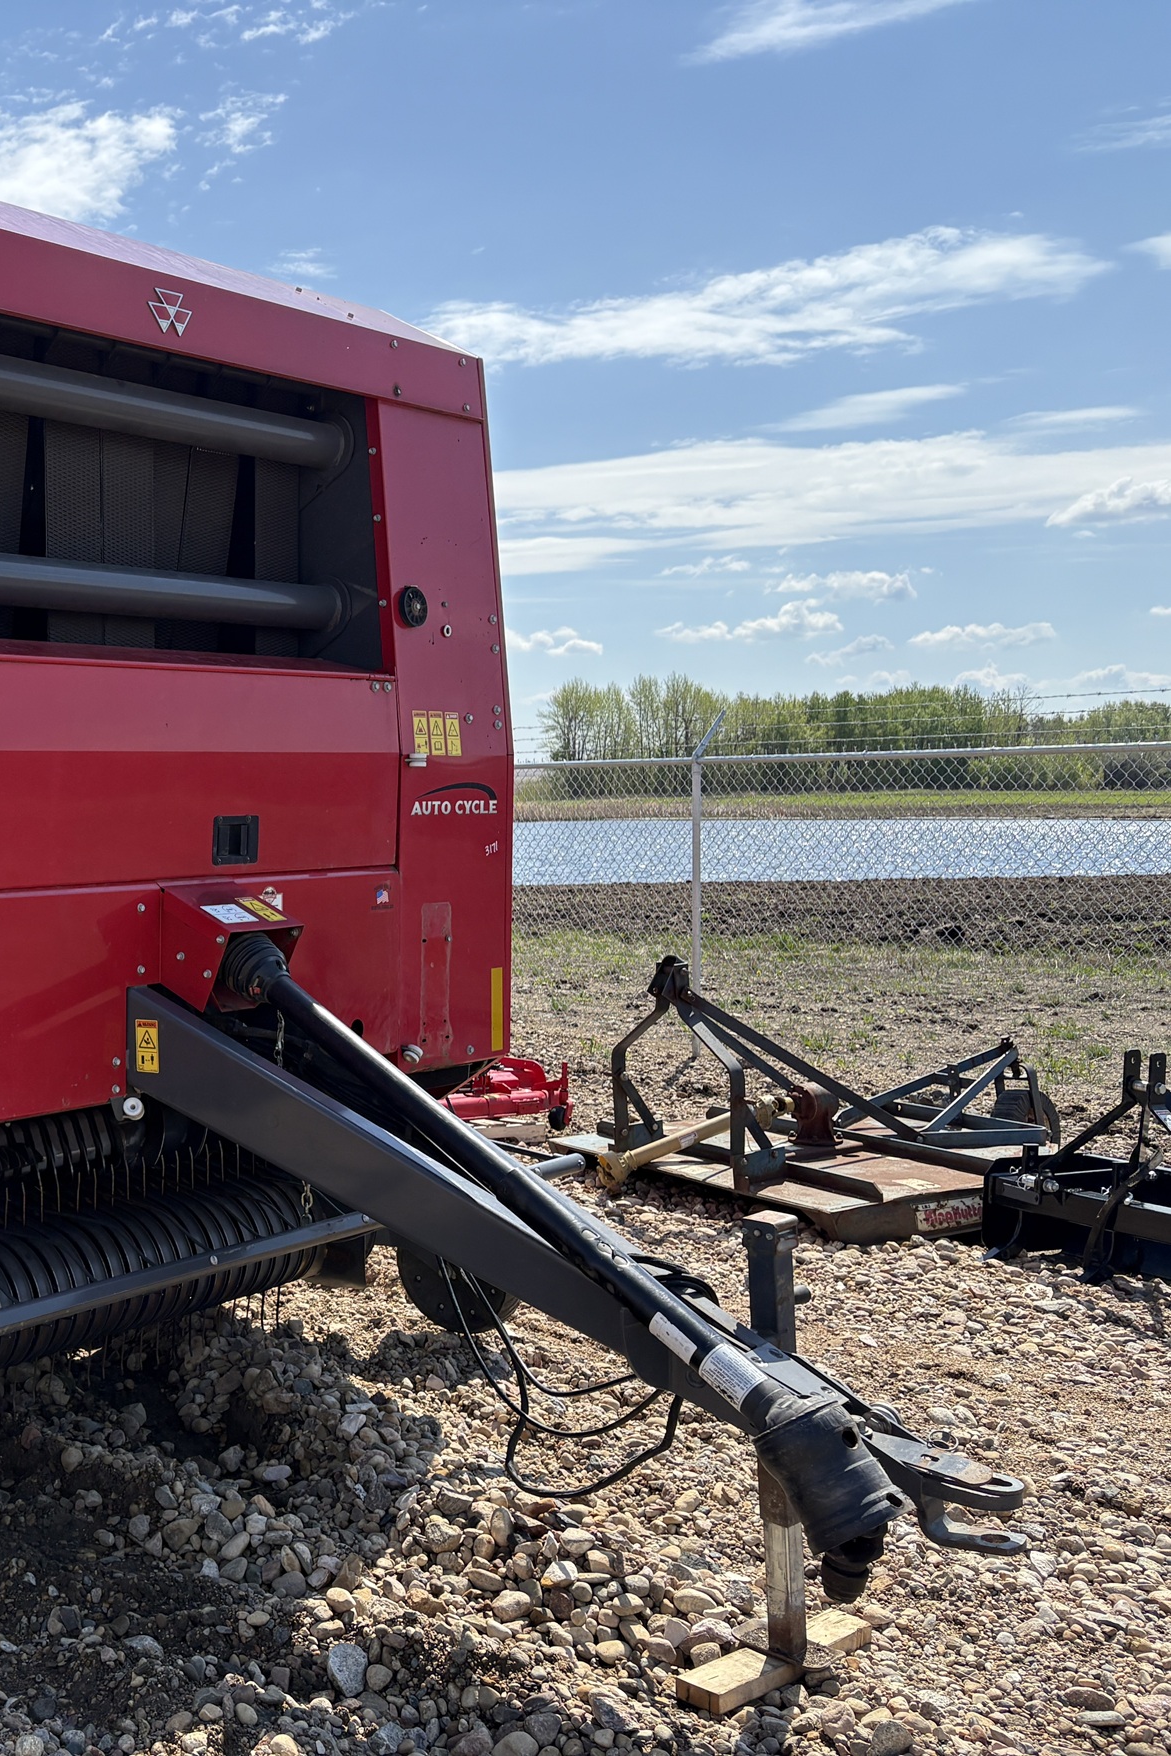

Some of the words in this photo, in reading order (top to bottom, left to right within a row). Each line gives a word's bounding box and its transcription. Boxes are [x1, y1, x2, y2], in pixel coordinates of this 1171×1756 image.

[410, 800, 452, 816] AUTO
[454, 799, 498, 814] CYCLE
[484, 840, 499, 857] 3171
